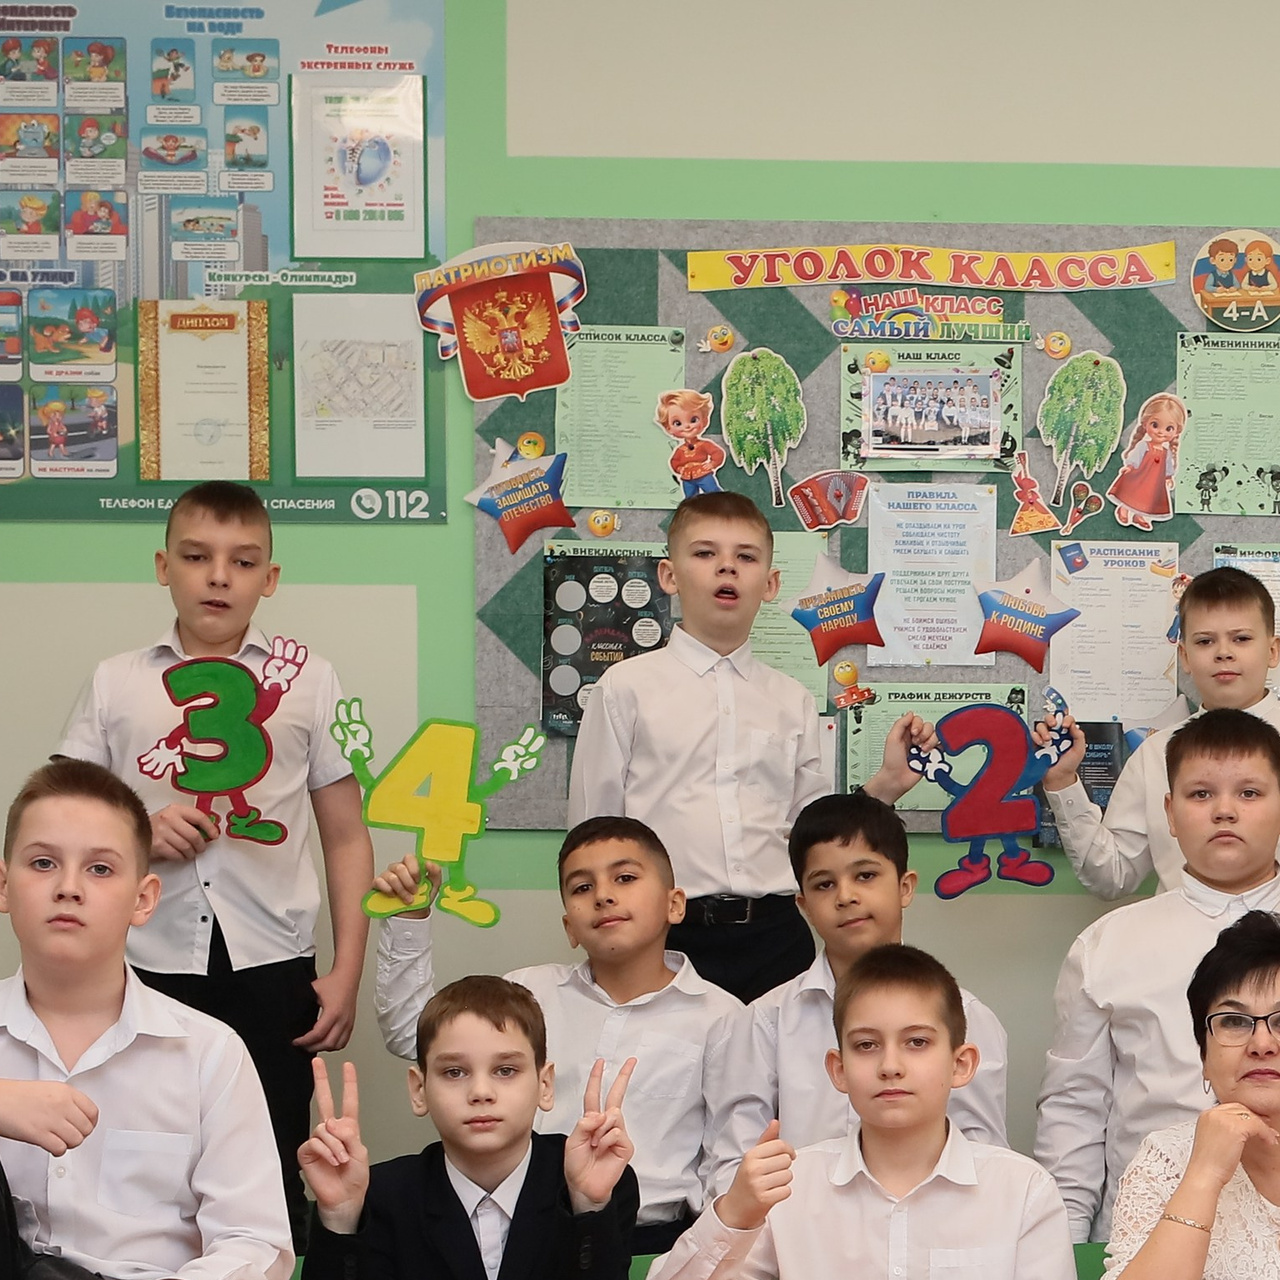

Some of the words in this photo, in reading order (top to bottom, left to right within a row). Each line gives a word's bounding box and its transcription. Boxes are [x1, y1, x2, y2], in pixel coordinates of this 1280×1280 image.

[415, 243, 575, 292] ПАТРИОТИЗМ
[726, 248, 934, 286] УГОЛОК
[950, 251, 1157, 290] КЛАССА
[862, 288, 919, 315] НАШ
[924, 296, 1004, 315] КЛАСС
[177, 317, 229, 328] ДИПЛОМ
[832, 317, 931, 340] САМЫЙ
[938, 319, 1032, 342] ЛУЧШИЙ
[578, 331, 622, 342] СПИСОК
[625, 333, 668, 343] КЛАССА
[1203, 339, 1280, 349] ИМЕНИННИКИ
[926, 353, 961, 361] КЛАСС
[488, 466, 546, 498] ГОТОВНОСТЬ
[99, 498, 155, 509] ТЕЛЕФОН
[270, 499, 336, 510] СПАСЕНИЯ
[385, 490, 430, 519] 112
[495, 482, 550, 510] ЗАЩИЩАТЬ
[907, 490, 958, 499] ПРАВИЛА
[502, 493, 554, 522] ОТЕЧЕСТВО
[887, 502, 932, 510] НАШЕГО
[935, 503, 978, 511] КЛАССА
[572, 547, 653, 557] ВНЕКЛАССНЫЕ
[1089, 548, 1161, 557] РАСПИСАНИЕ
[1103, 559, 1146, 568] УРОКОВ
[798, 582, 866, 610] ПРЕДАННОСТЬ
[999, 593, 1048, 619] ЛЮБОВЬ
[817, 599, 855, 620] СВОЕМУ
[820, 612, 858, 633] НАРОДУ
[990, 610, 1000, 624] К
[999, 613, 1047, 639] РОДИНЕ
[887, 692, 931, 701] ГРАФИК
[933, 692, 992, 701] ДЕЖУРСТВ
[162, 656, 273, 796] 3
[935, 702, 1041, 843] 2
[362, 717, 487, 866] 4
